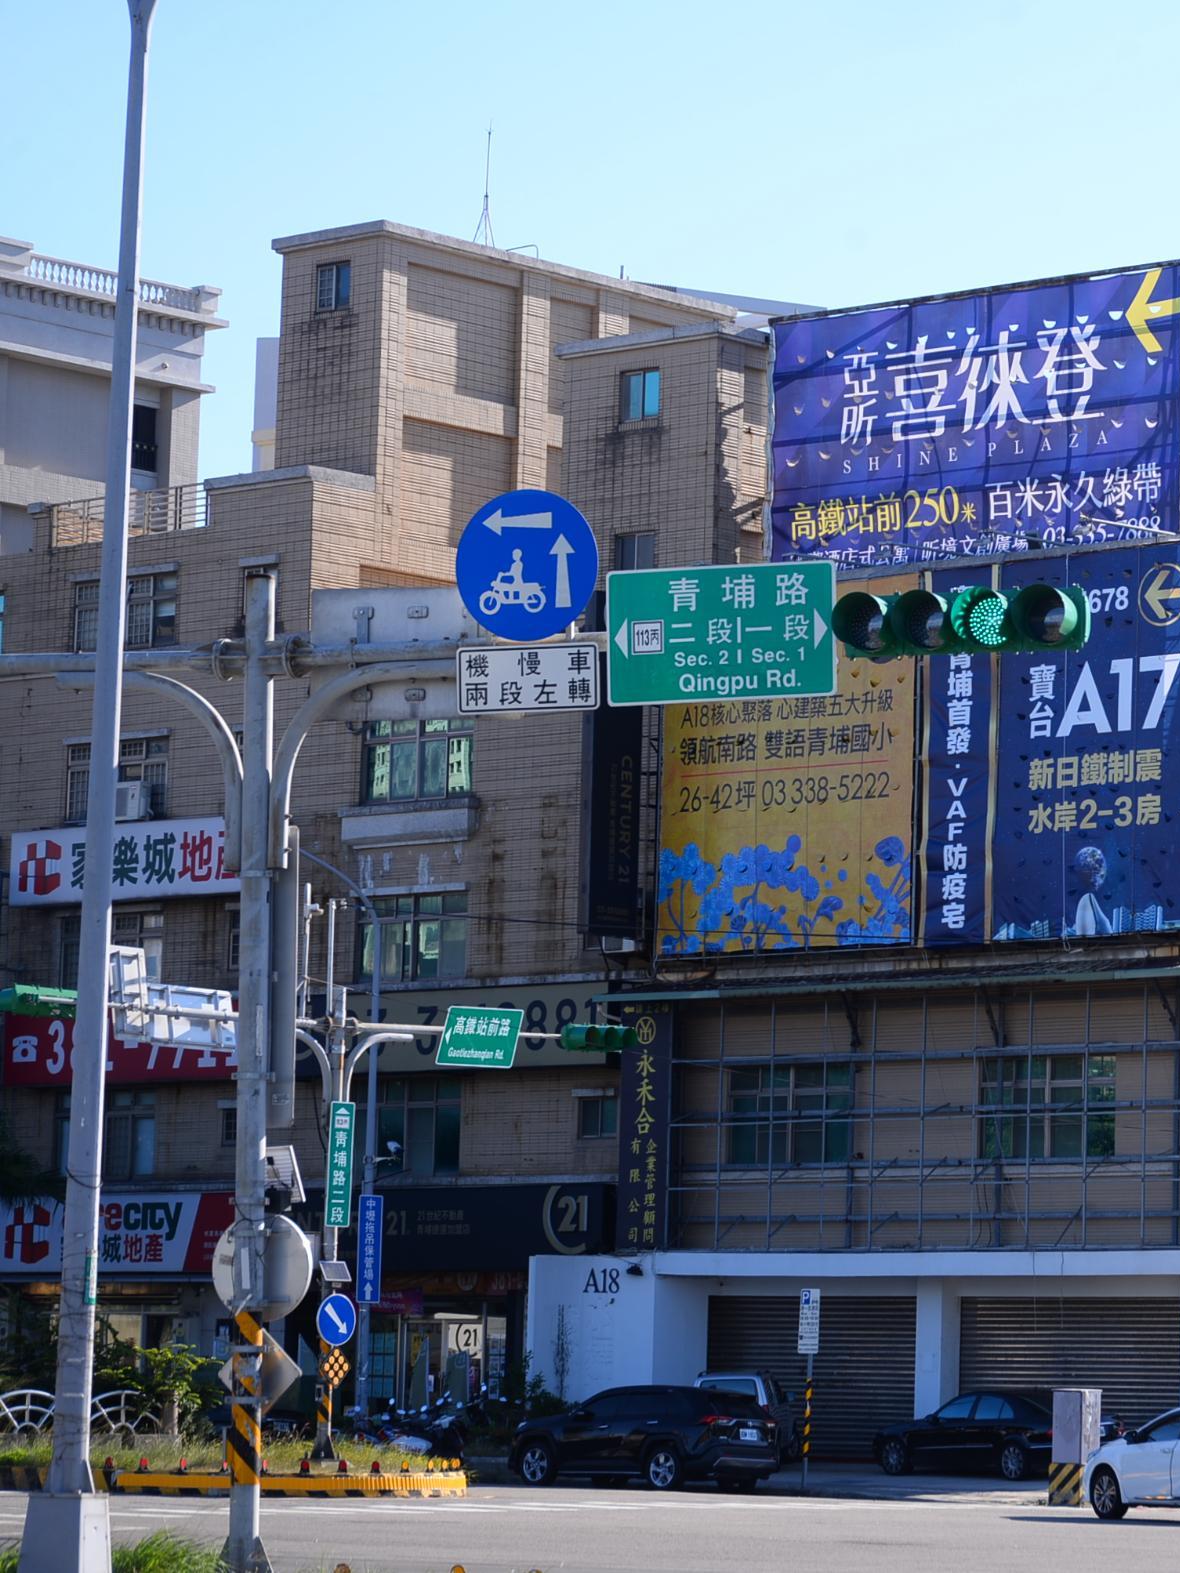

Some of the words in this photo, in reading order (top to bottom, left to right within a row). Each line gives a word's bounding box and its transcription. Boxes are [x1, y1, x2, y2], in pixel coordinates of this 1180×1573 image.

[840, 348, 880, 446] 亞昕
[842, 448, 958, 474] SHINE
[987, 430, 1109, 456] PLAZA
[789, 485, 977, 541] 高鐵站前250米
[986, 463, 1162, 520] 百米永久綠帶
[668, 572, 809, 612] 青埔路
[1084, 586, 1129, 614] 678
[635, 628, 662, 649] 113丙
[669, 617, 732, 646] 二段
[745, 613, 811, 643] 一段
[465, 649, 592, 677] 機慢車
[674, 651, 712, 668] Sec.
[719, 650, 729, 665] 2
[752, 648, 790, 664] Sec.
[797, 648, 806, 662] 1
[464, 677, 593, 707] 兩段左轉
[678, 670, 758, 695] Qingpu
[766, 669, 802, 690] Rd.
[1029, 664, 1057, 739] 寶台
[680, 733, 757, 766] 領航南路
[764, 721, 893, 761] 雙語青埔國小
[1028, 749, 1163, 792] 新日鐵制震
[680, 780, 756, 814] 26-42坪
[1027, 793, 1163, 835] 水岸2-3房
[452, 1016, 511, 1037] 高鐵站前路
[495, 1048, 504, 1060] Rd.
[331, 1131, 348, 1223] 青埔路二段
[628, 1137, 641, 1243] 有限公司
[583, 1268, 620, 1294] A18
